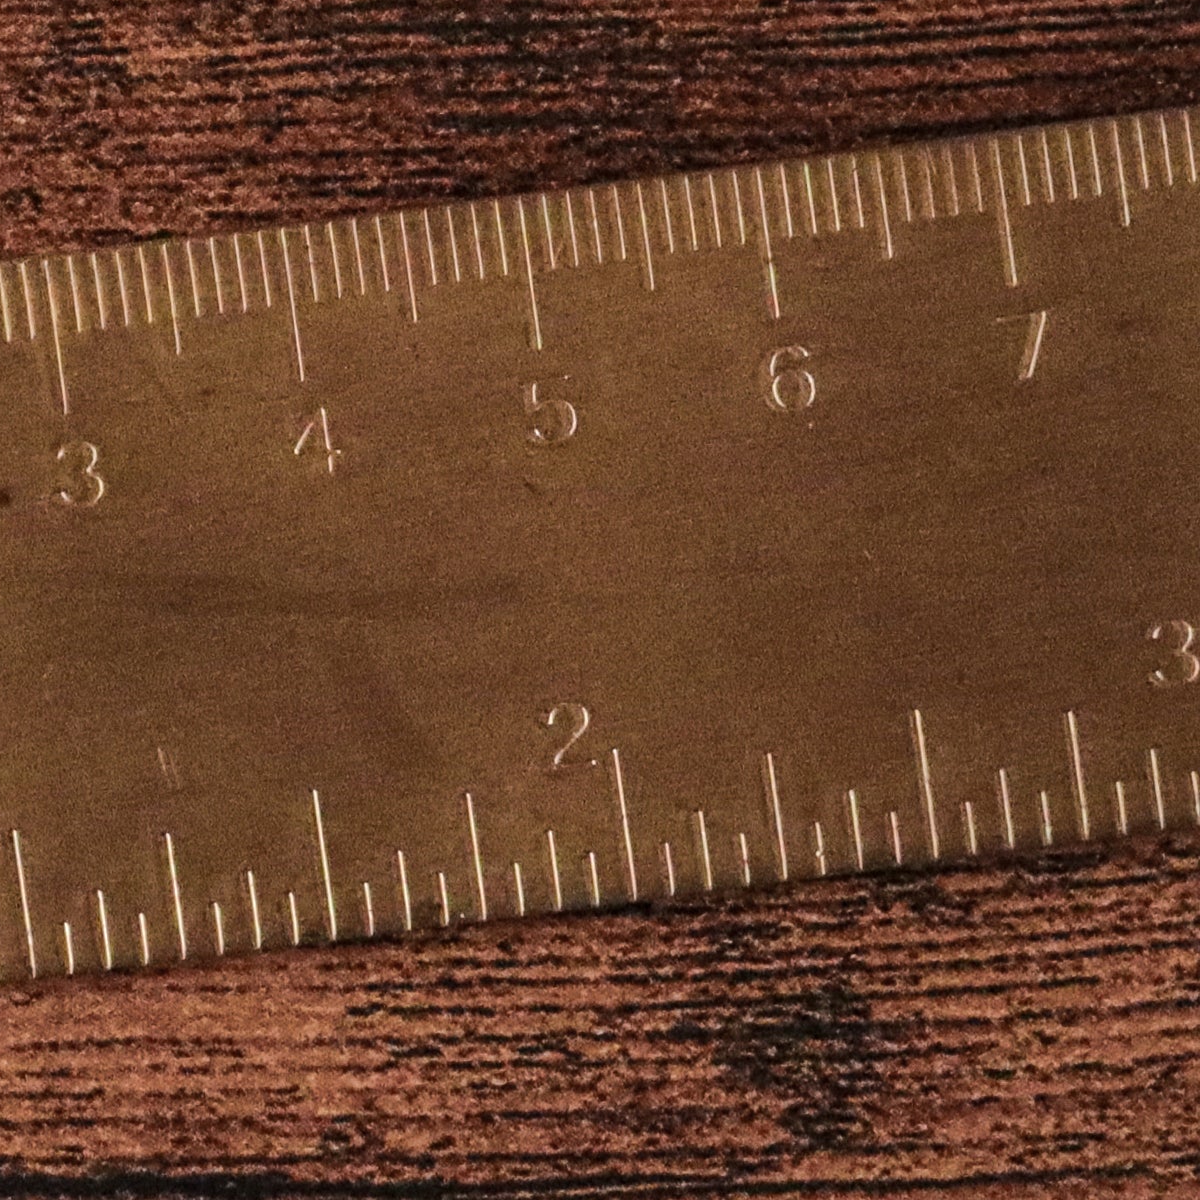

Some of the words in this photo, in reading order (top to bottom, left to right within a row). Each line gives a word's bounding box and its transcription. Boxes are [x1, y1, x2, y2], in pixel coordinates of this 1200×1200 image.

[56, 440, 105, 505] 3
[293, 406, 342, 474] 4
[530, 374, 578, 444] 5
[769, 345, 817, 410] 6
[996, 309, 1047, 380] 7
[546, 701, 598, 766] 2
[1149, 618, 1200, 684] 3
